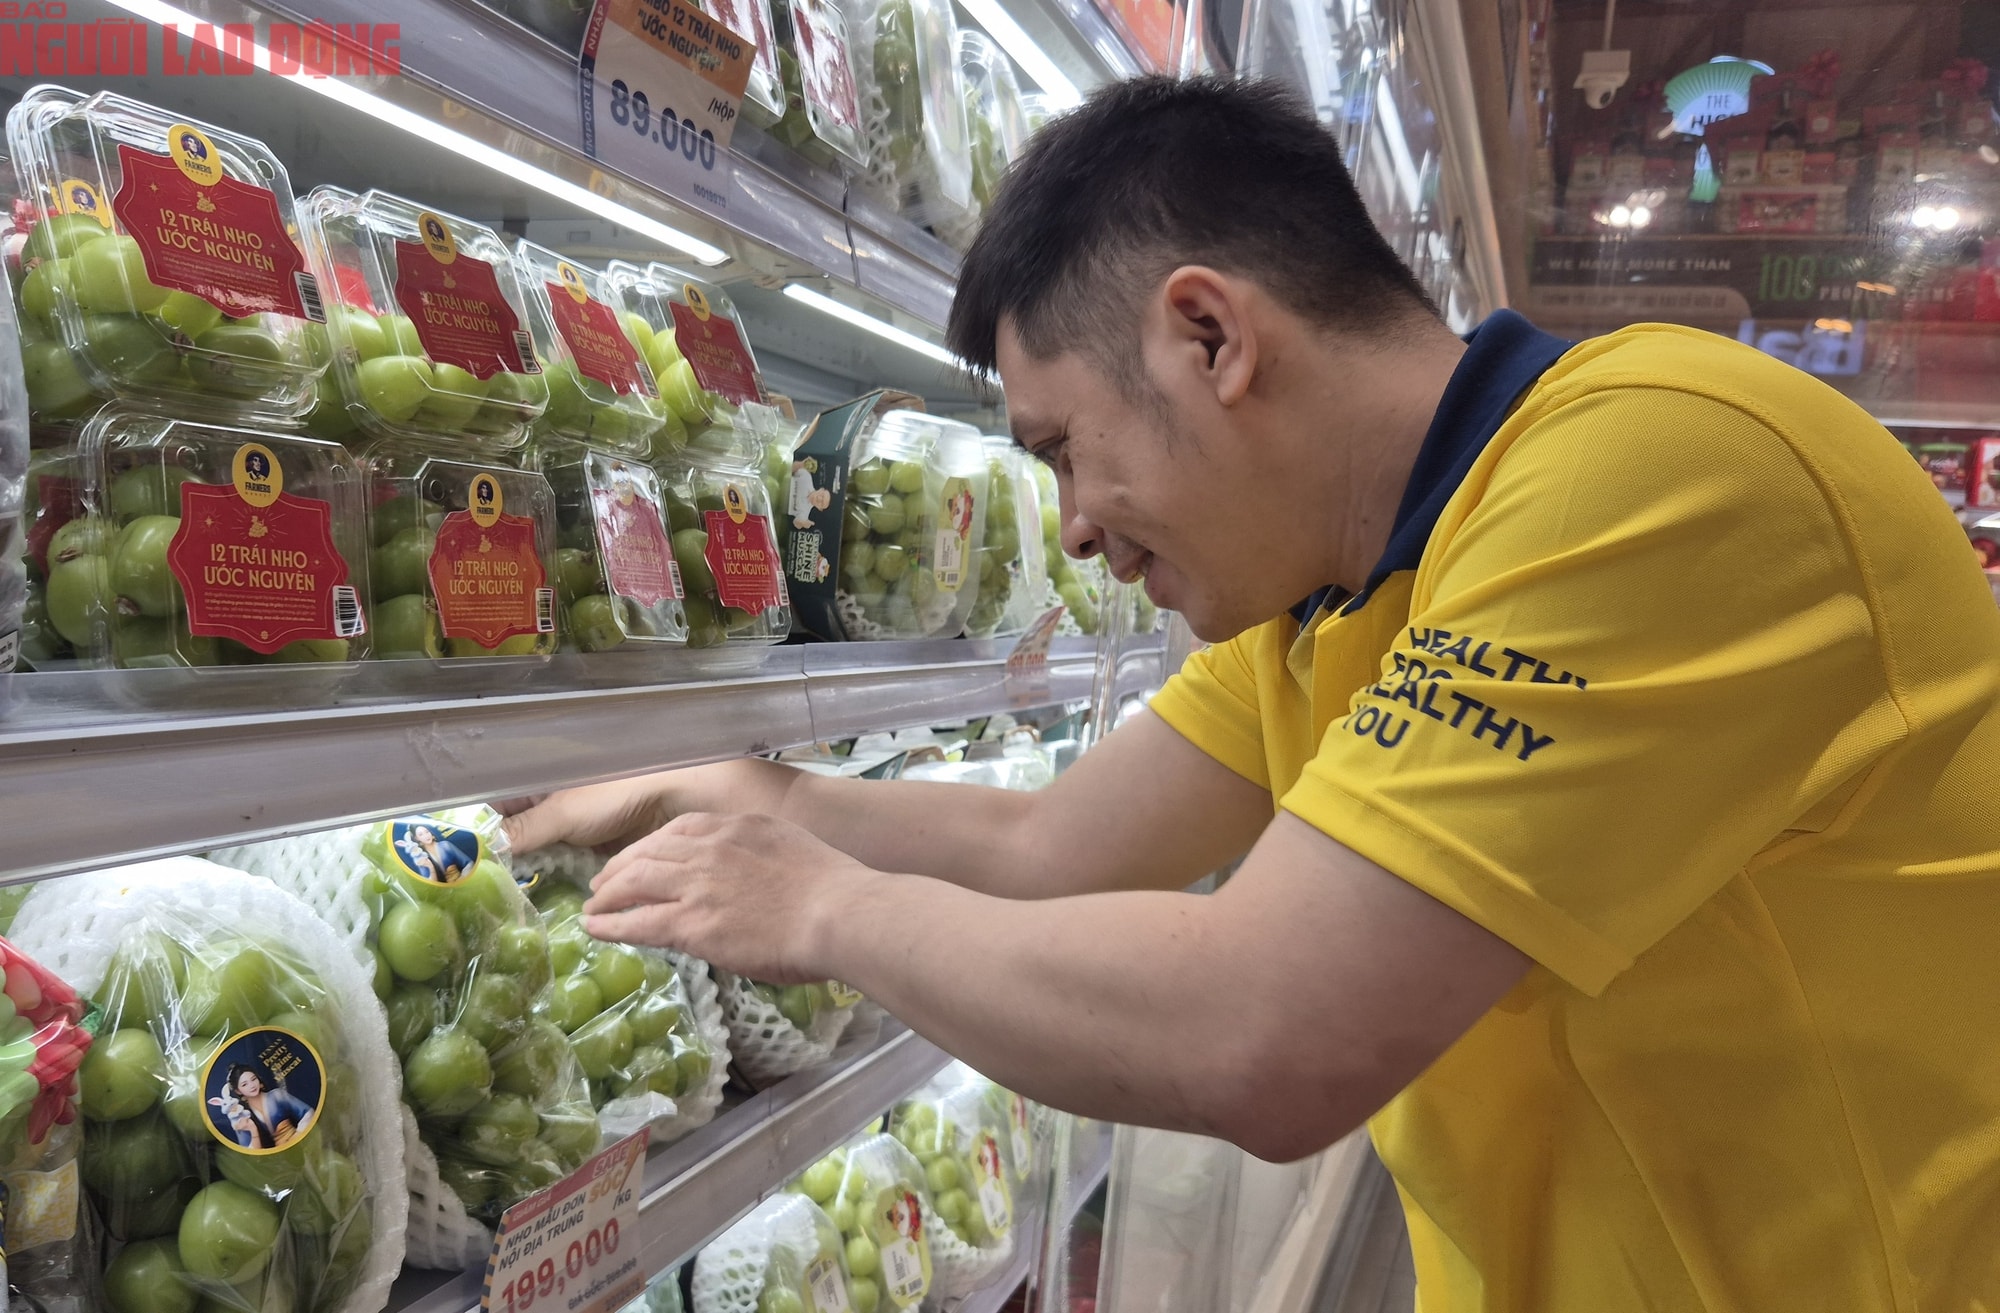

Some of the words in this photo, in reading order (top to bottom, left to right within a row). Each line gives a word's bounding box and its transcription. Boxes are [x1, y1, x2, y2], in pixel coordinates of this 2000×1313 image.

[588, 4, 604, 50] NHẬP
[673, 8, 685, 27] 12
[689, 14, 713, 45] TRÁI
[716, 31, 741, 60] NHO
[707, 97, 736, 123] /HỘP
[1707, 94, 1731, 109] THE
[610, 79, 716, 171] 89.000
[184, 159, 212, 175] FARMERS
[160, 207, 178, 228] 12
[179, 213, 221, 240] TRÁI
[222, 225, 263, 250] NHO
[156, 226, 203, 254] ƯỚC
[203, 238, 275, 273] NGUYỆN
[1548, 259, 1575, 271] WE
[1629, 259, 1680, 271] MORE
[1684, 259, 1734, 272] THAN
[1758, 254, 1818, 301] 100
[423, 304, 453, 326] ƯỚC
[453, 314, 501, 336] NGUYỆN
[435, 293, 461, 312] TRÁI
[464, 298, 490, 317] NHO
[244, 482, 271, 494] FARMERS
[211, 543, 226, 562] 12
[229, 544, 267, 567] TRÁI
[271, 549, 308, 569] NHO
[454, 560, 464, 576] 12
[466, 558, 491, 576] TRÁI
[493, 561, 519, 577] NHO
[723, 548, 733, 560] 12
[733, 547, 749, 561] TRÁI
[748, 550, 765, 561] NHO
[796, 531, 806, 580] MUSCAT
[803, 532, 814, 581] SHINE
[204, 564, 245, 586] ƯỚC
[249, 569, 316, 594] NGUYỆN
[742, 562, 770, 577] NGUYỆN
[449, 577, 476, 595] ƯỚC
[478, 577, 524, 598] NGUYỆN
[1409, 627, 1588, 692] HEALTH
[1342, 703, 1411, 749] YOU
[263, 1044, 287, 1067] Pretty
[270, 1052, 294, 1071] Shine
[612, 1189, 632, 1211] /KG
[504, 1226, 532, 1251] NHO
[562, 1192, 586, 1215] ĐƠN
[499, 1248, 520, 1273] NỘI
[522, 1236, 544, 1256] ĐỊA
[546, 1210, 584, 1242] TRUNG
[502, 1217, 620, 1313] 199,000
